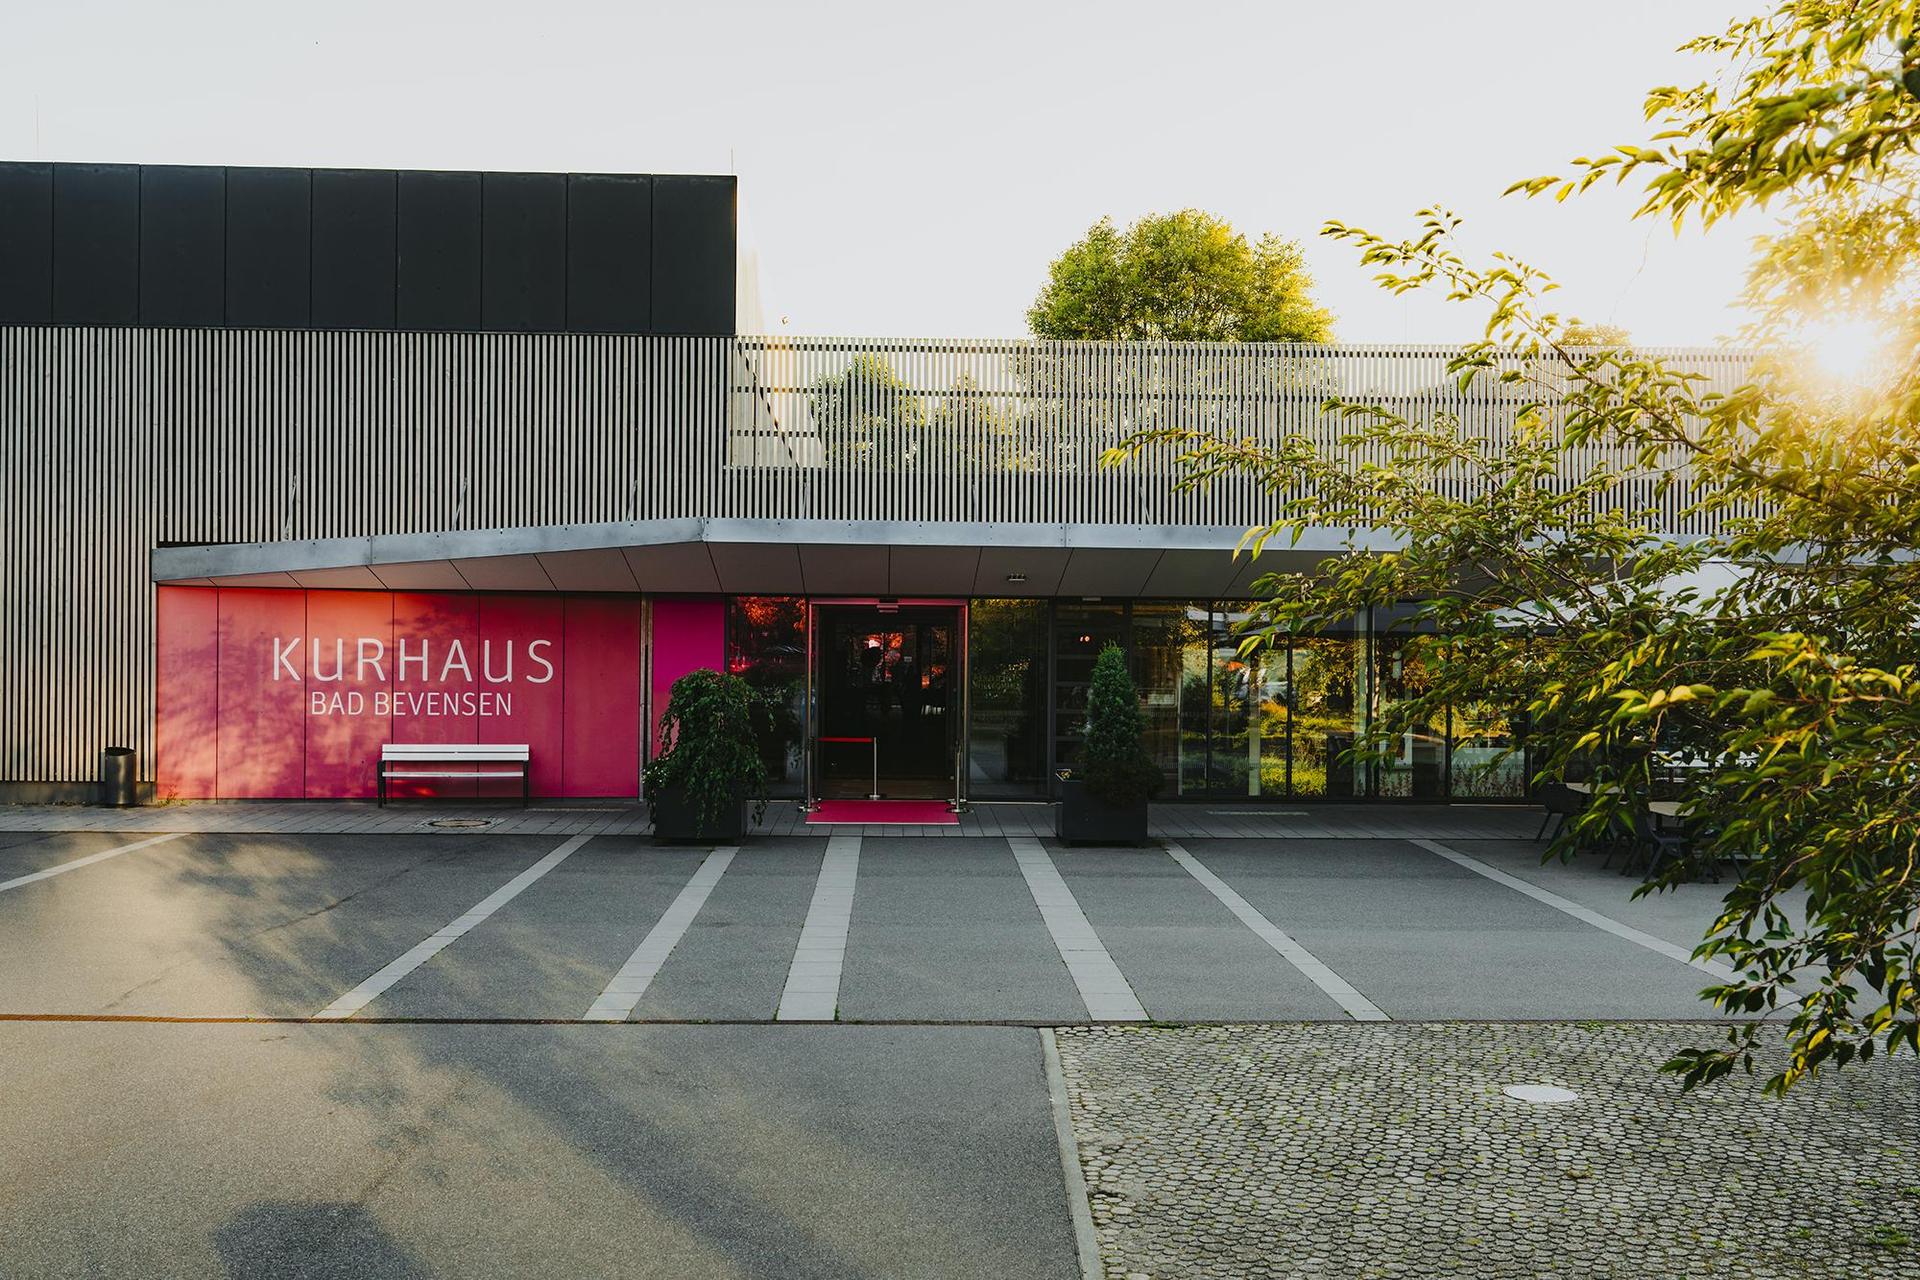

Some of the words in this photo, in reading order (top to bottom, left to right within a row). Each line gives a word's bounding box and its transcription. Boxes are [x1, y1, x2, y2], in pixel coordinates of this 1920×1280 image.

[273, 637, 554, 683] KURHAUS
[311, 691, 364, 716] BAD
[375, 692, 512, 716] BEVENSEN
